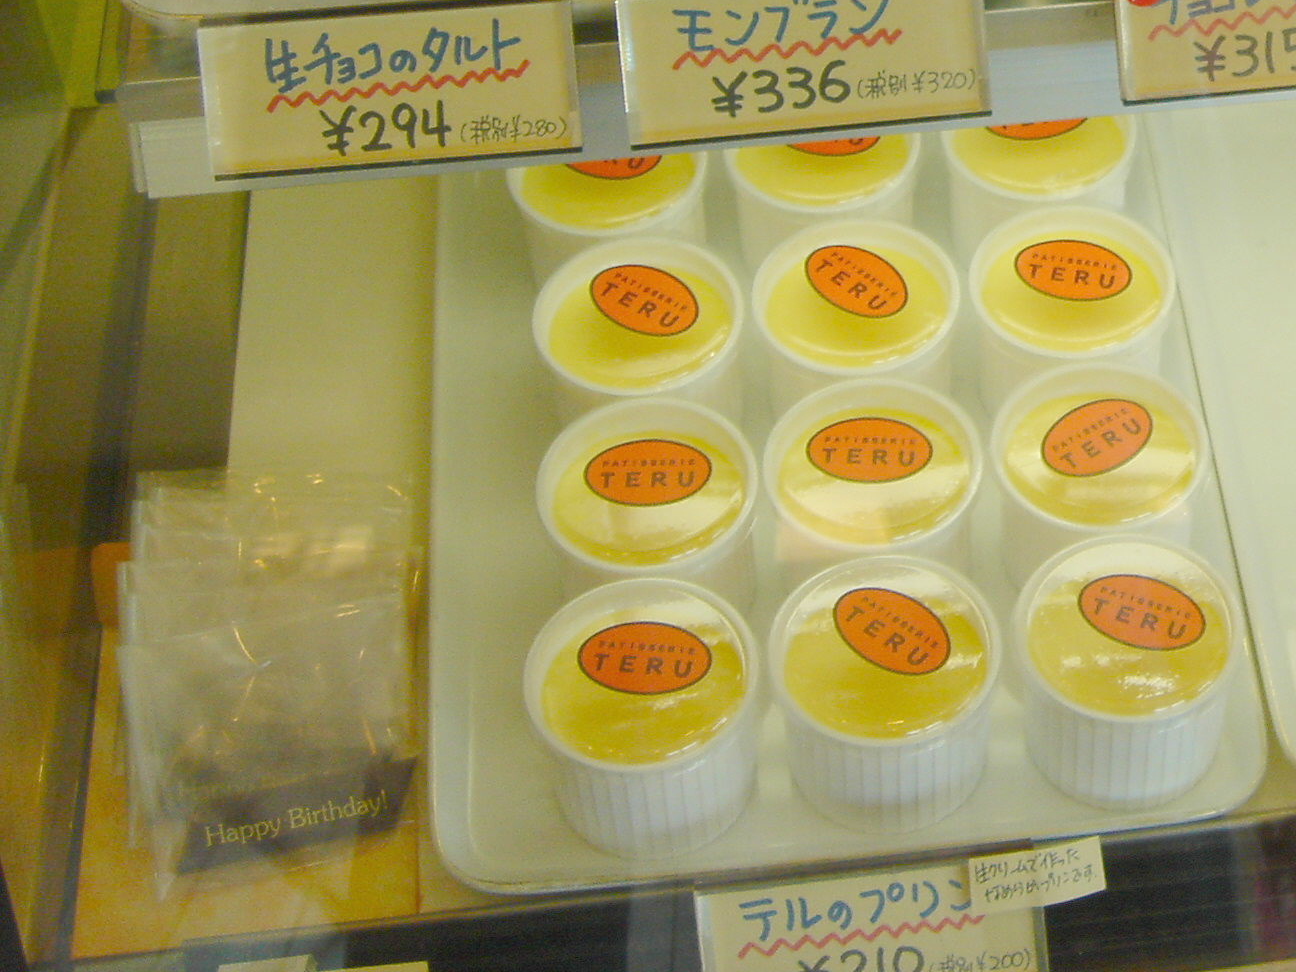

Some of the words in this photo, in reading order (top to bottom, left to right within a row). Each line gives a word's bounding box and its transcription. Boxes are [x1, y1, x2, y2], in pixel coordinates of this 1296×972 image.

[264, 18, 521, 93] 生チョコのタルト
[710, 59, 852, 118] ¥336
[318, 99, 452, 156] ¥294
[816, 258, 887, 310] TERU
[1029, 263, 1115, 289] TERU
[601, 281, 680, 327] TERU
[822, 447, 915, 467] TERU
[1059, 418, 1141, 468] TERU
[600, 470, 695, 488] TERU
[845, 606, 929, 665] TERU
[1094, 598, 1187, 639] TERU
[594, 653, 694, 678] TERU
[205, 816, 281, 848] Happy
[286, 789, 388, 829] Birthday!
